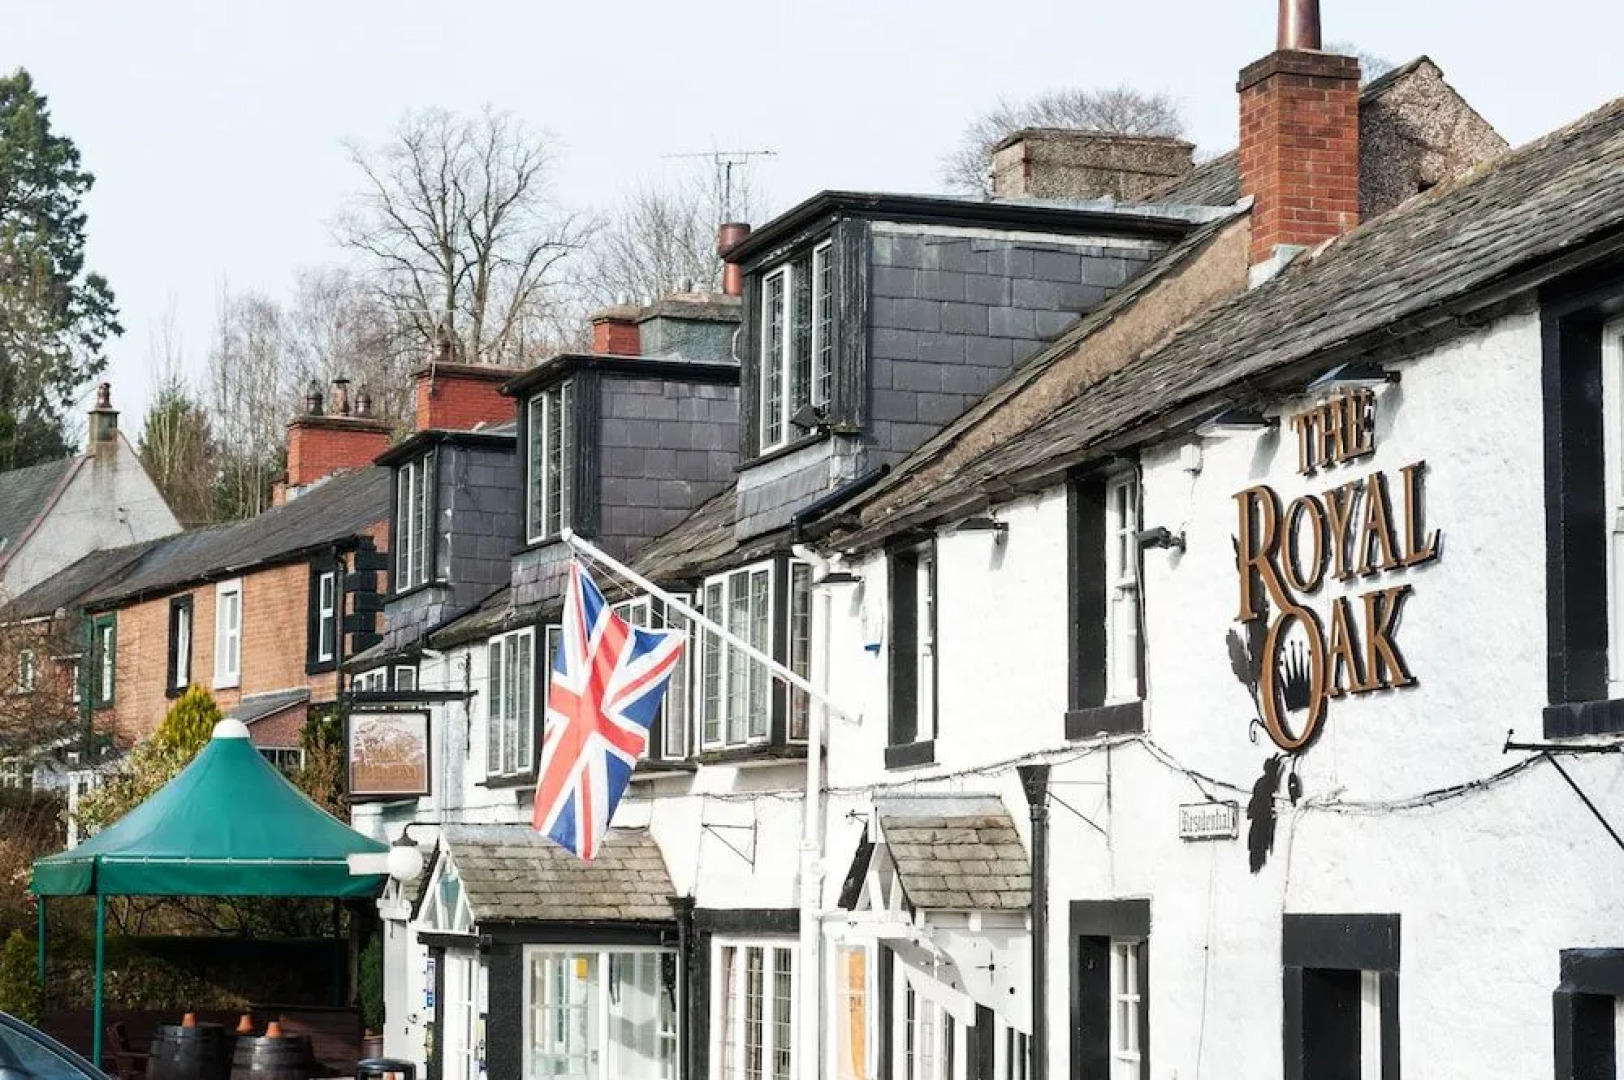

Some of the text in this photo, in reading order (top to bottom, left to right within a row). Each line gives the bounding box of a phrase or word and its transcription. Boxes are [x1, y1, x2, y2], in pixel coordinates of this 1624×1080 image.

[1291, 388, 1376, 474] THE
[1233, 460, 1439, 622] ROYAL
[1261, 585, 1416, 751] OAK
